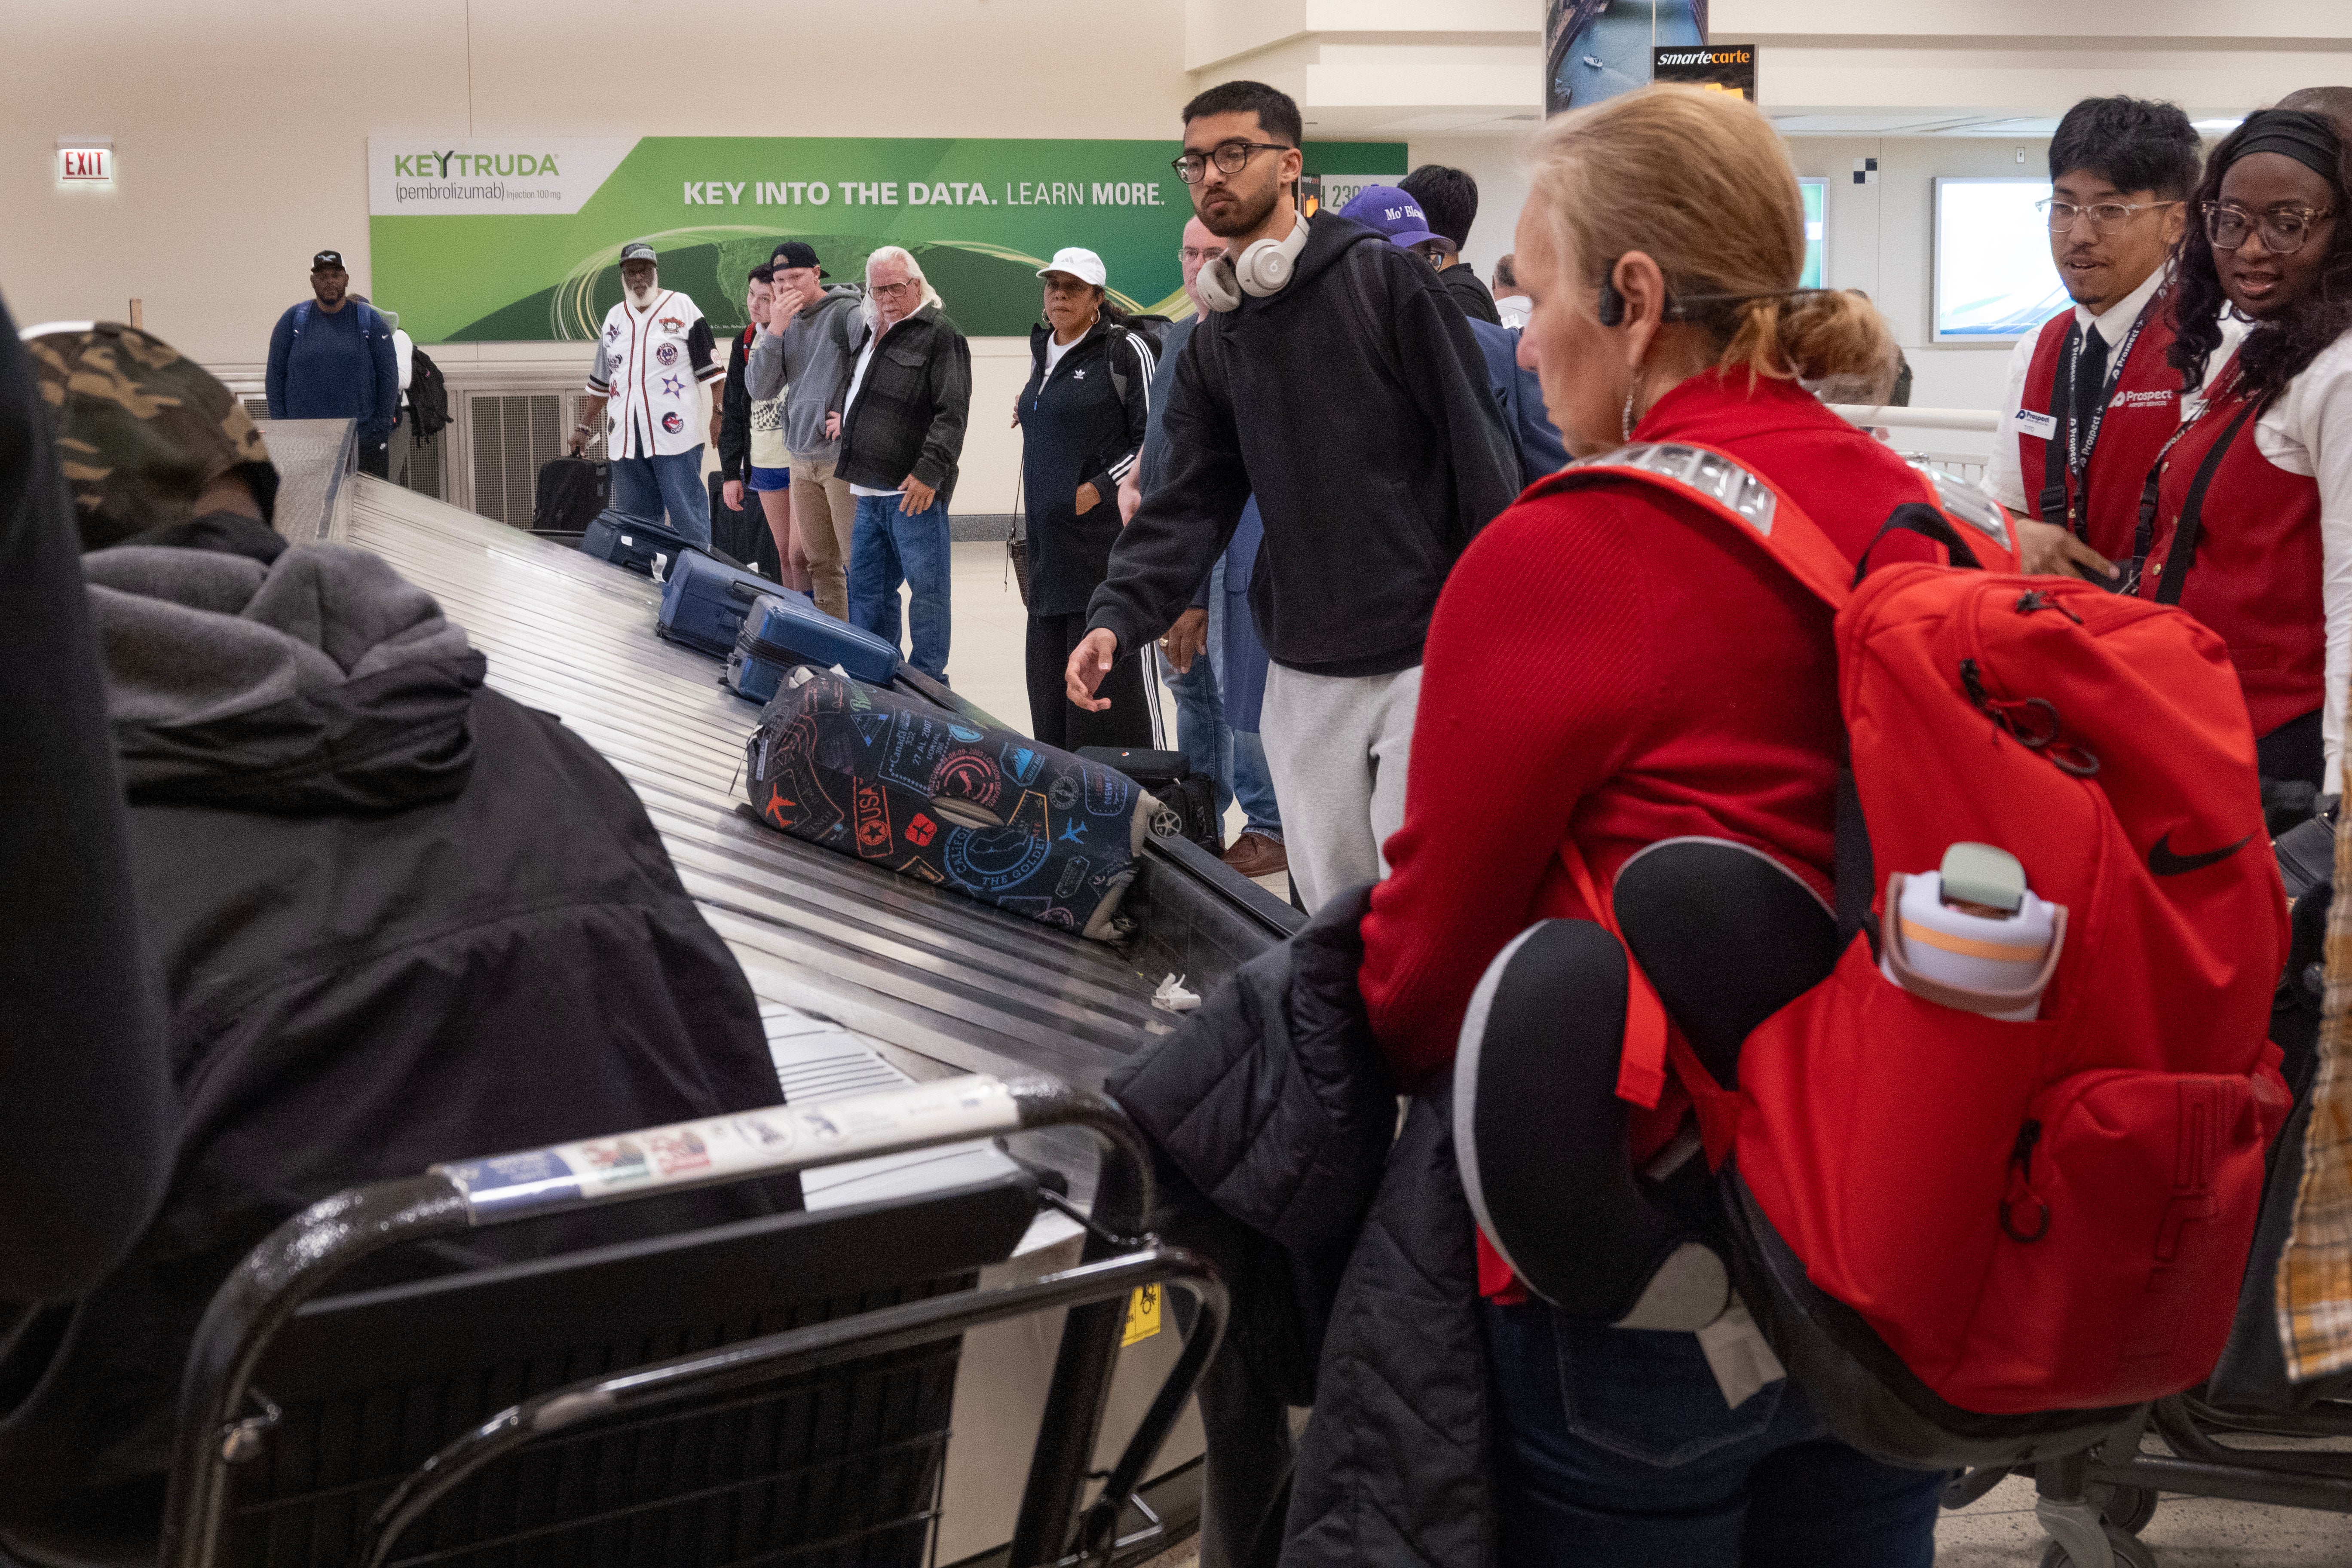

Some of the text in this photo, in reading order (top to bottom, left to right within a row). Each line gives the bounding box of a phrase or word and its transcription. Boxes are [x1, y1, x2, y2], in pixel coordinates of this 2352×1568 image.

[1657, 49, 1750, 65] smartecarte
[65, 151, 104, 175] EXIT
[395, 181, 561, 203] (pembrolizumab) Injection 100 mg
[683, 181, 1165, 206] KEY INTO THE DATA. LEARN MORE.
[2116, 330, 2140, 367] Prospect
[2126, 389, 2172, 401] Prospect
[2069, 427, 2078, 466] Prospect
[2081, 416, 2101, 456] Prospect
[859, 782, 882, 822] USA
[982, 874, 1008, 885] THE
